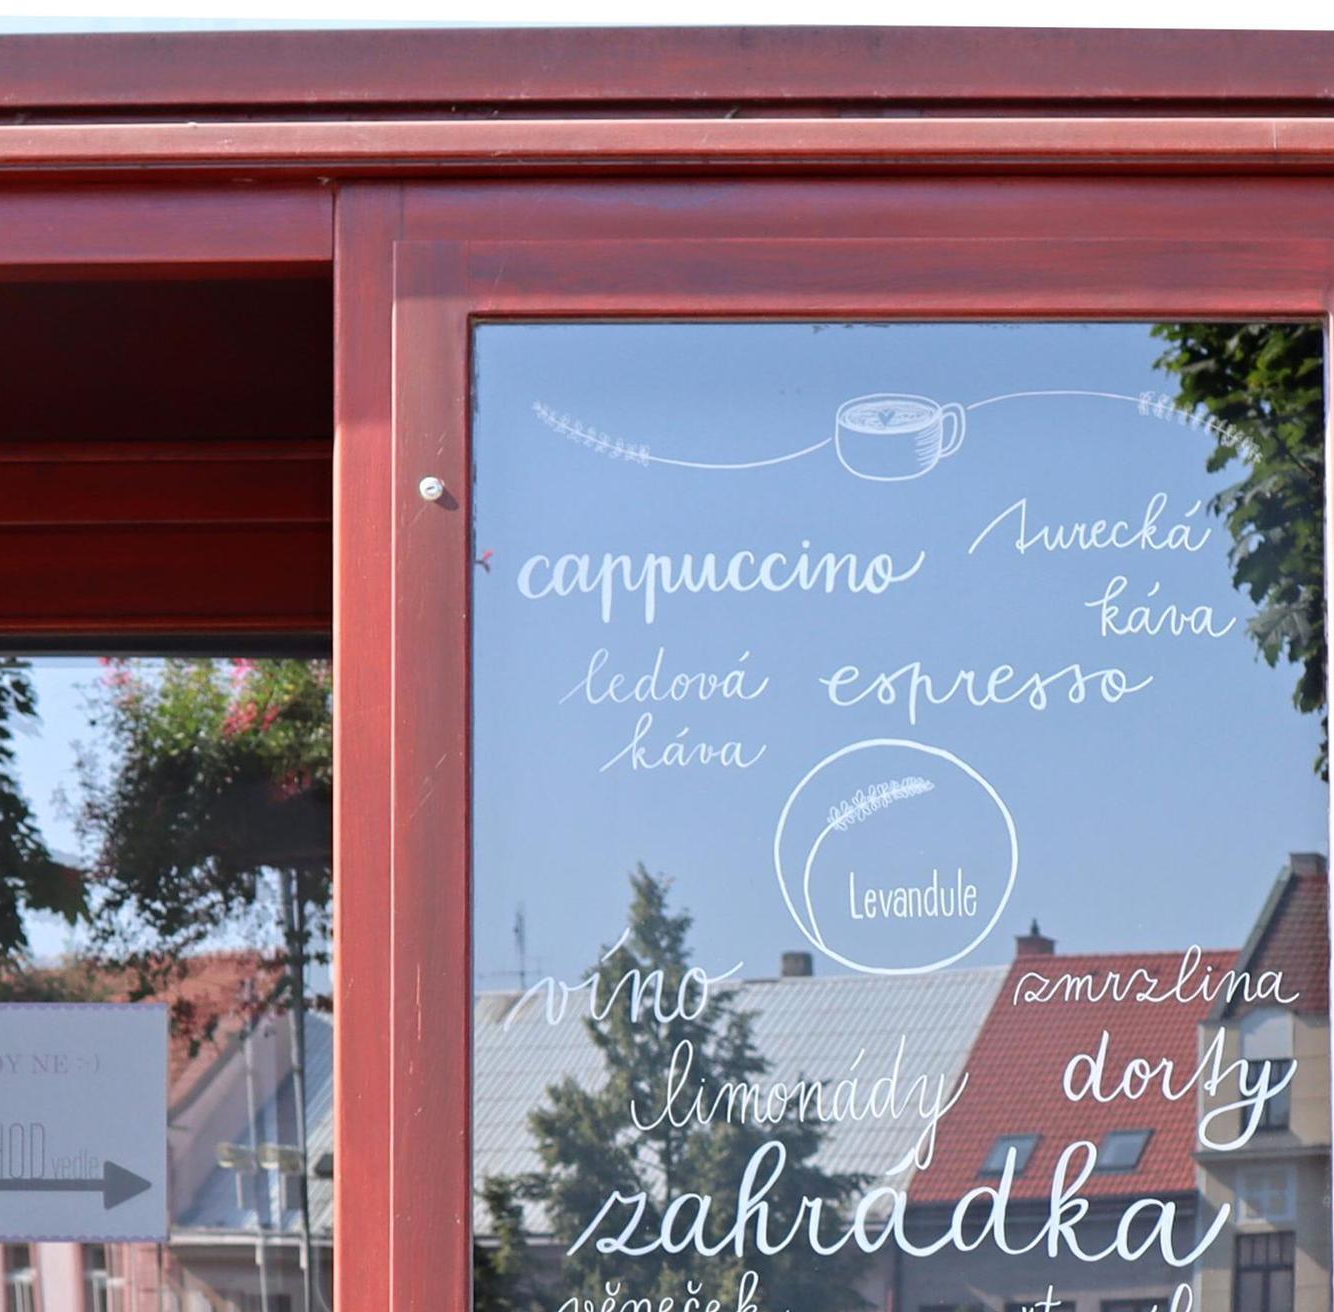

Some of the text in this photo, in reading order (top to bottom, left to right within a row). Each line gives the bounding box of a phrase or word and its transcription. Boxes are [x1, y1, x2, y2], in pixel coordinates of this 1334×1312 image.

[517, 539, 925, 623] cappuccino
[1085, 576, 1236, 637] káva
[559, 648, 768, 705] ledová
[820, 661, 1152, 725] espresso
[600, 711, 767, 771] káva
[849, 869, 977, 919] Levandule
[503, 927, 744, 1031] víno
[1014, 945, 1299, 1006] zmrzlina
[32, 1054, 68, 1075] NE
[1063, 1027, 1298, 1151] dorty
[631, 1035, 969, 1170] limonády
[566, 1137, 1231, 1268] zahrádka
